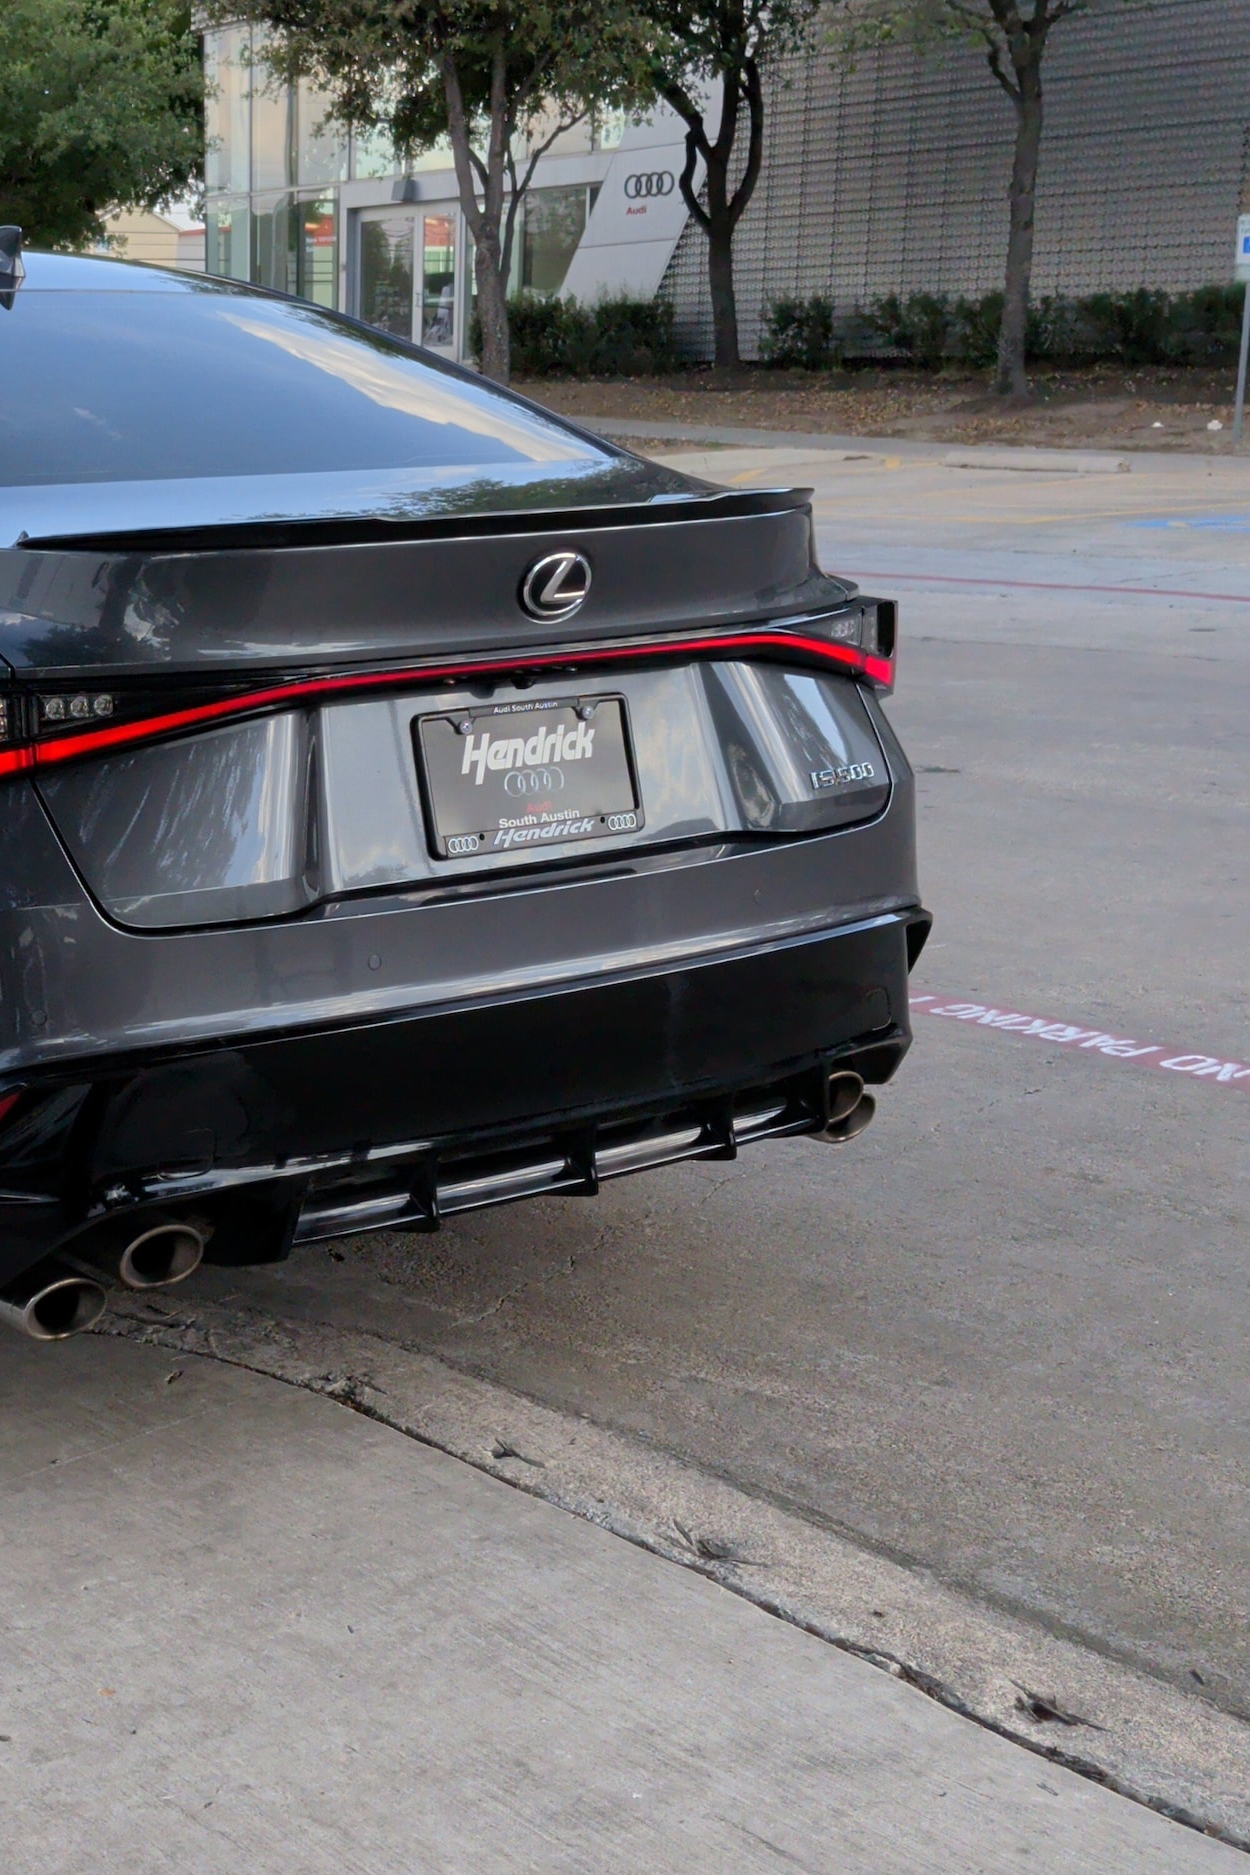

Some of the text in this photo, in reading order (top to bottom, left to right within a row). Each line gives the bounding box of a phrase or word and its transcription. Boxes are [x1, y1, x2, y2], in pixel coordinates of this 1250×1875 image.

[626, 205, 647, 215] Audi
[493, 701, 558, 714] Audi South Austin
[461, 721, 595, 785] Hendrick
[526, 800, 552, 813] Audi
[498, 808, 580, 829] South Austin
[493, 818, 595, 848] Hendrick
[929, 1003, 1164, 1058] PARKING
